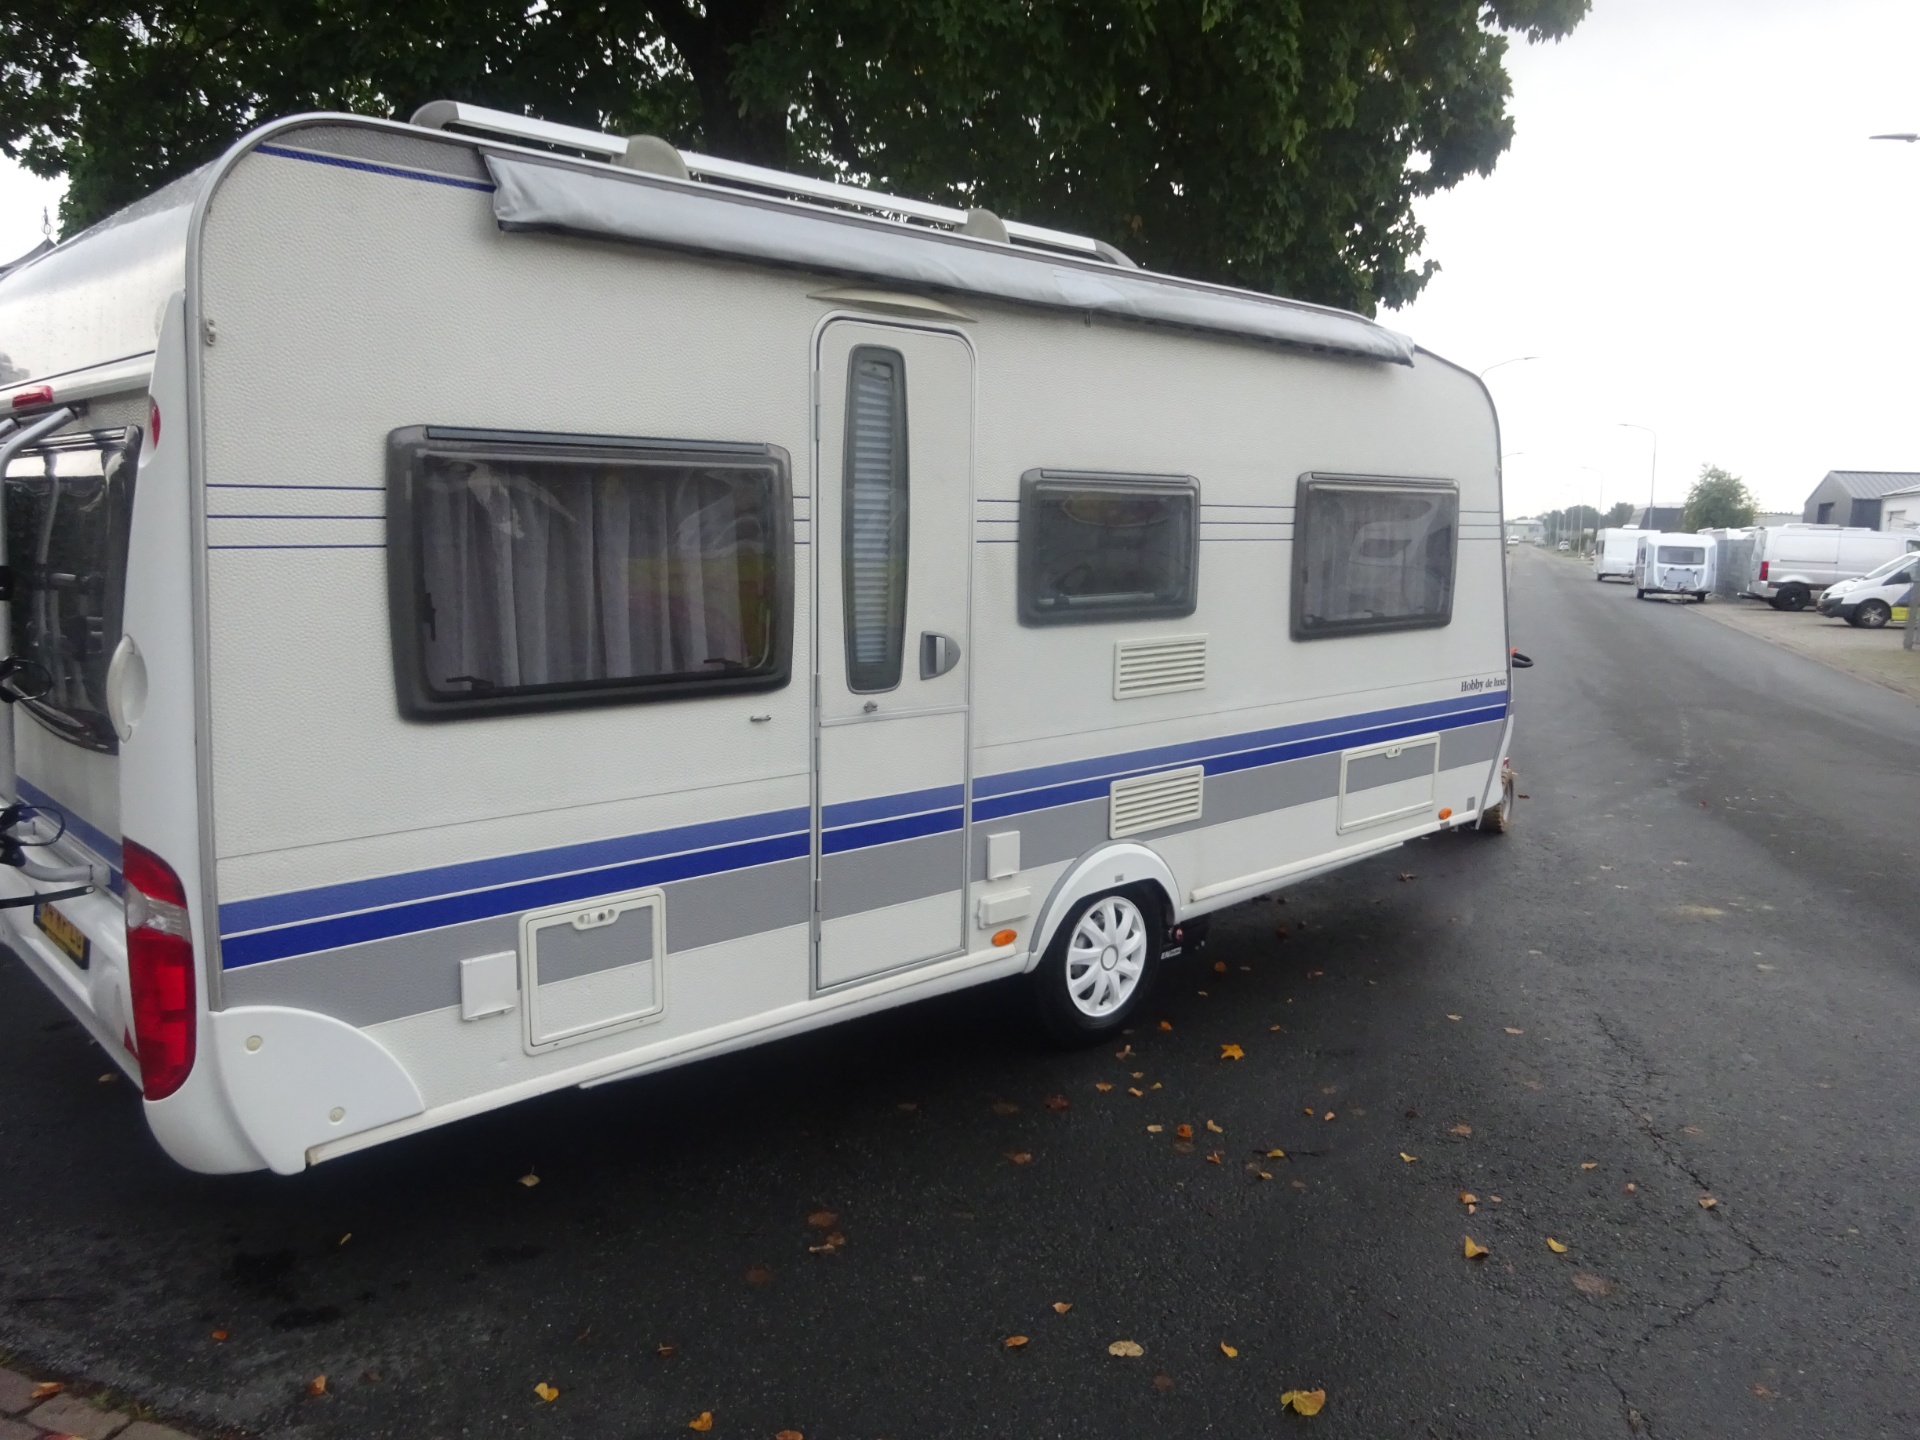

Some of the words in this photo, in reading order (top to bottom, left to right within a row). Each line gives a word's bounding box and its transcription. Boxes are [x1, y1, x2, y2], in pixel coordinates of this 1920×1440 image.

[1461, 678, 1484, 692] Hobby
[1485, 678, 1493, 688] de
[1493, 677, 1507, 687] luxe
